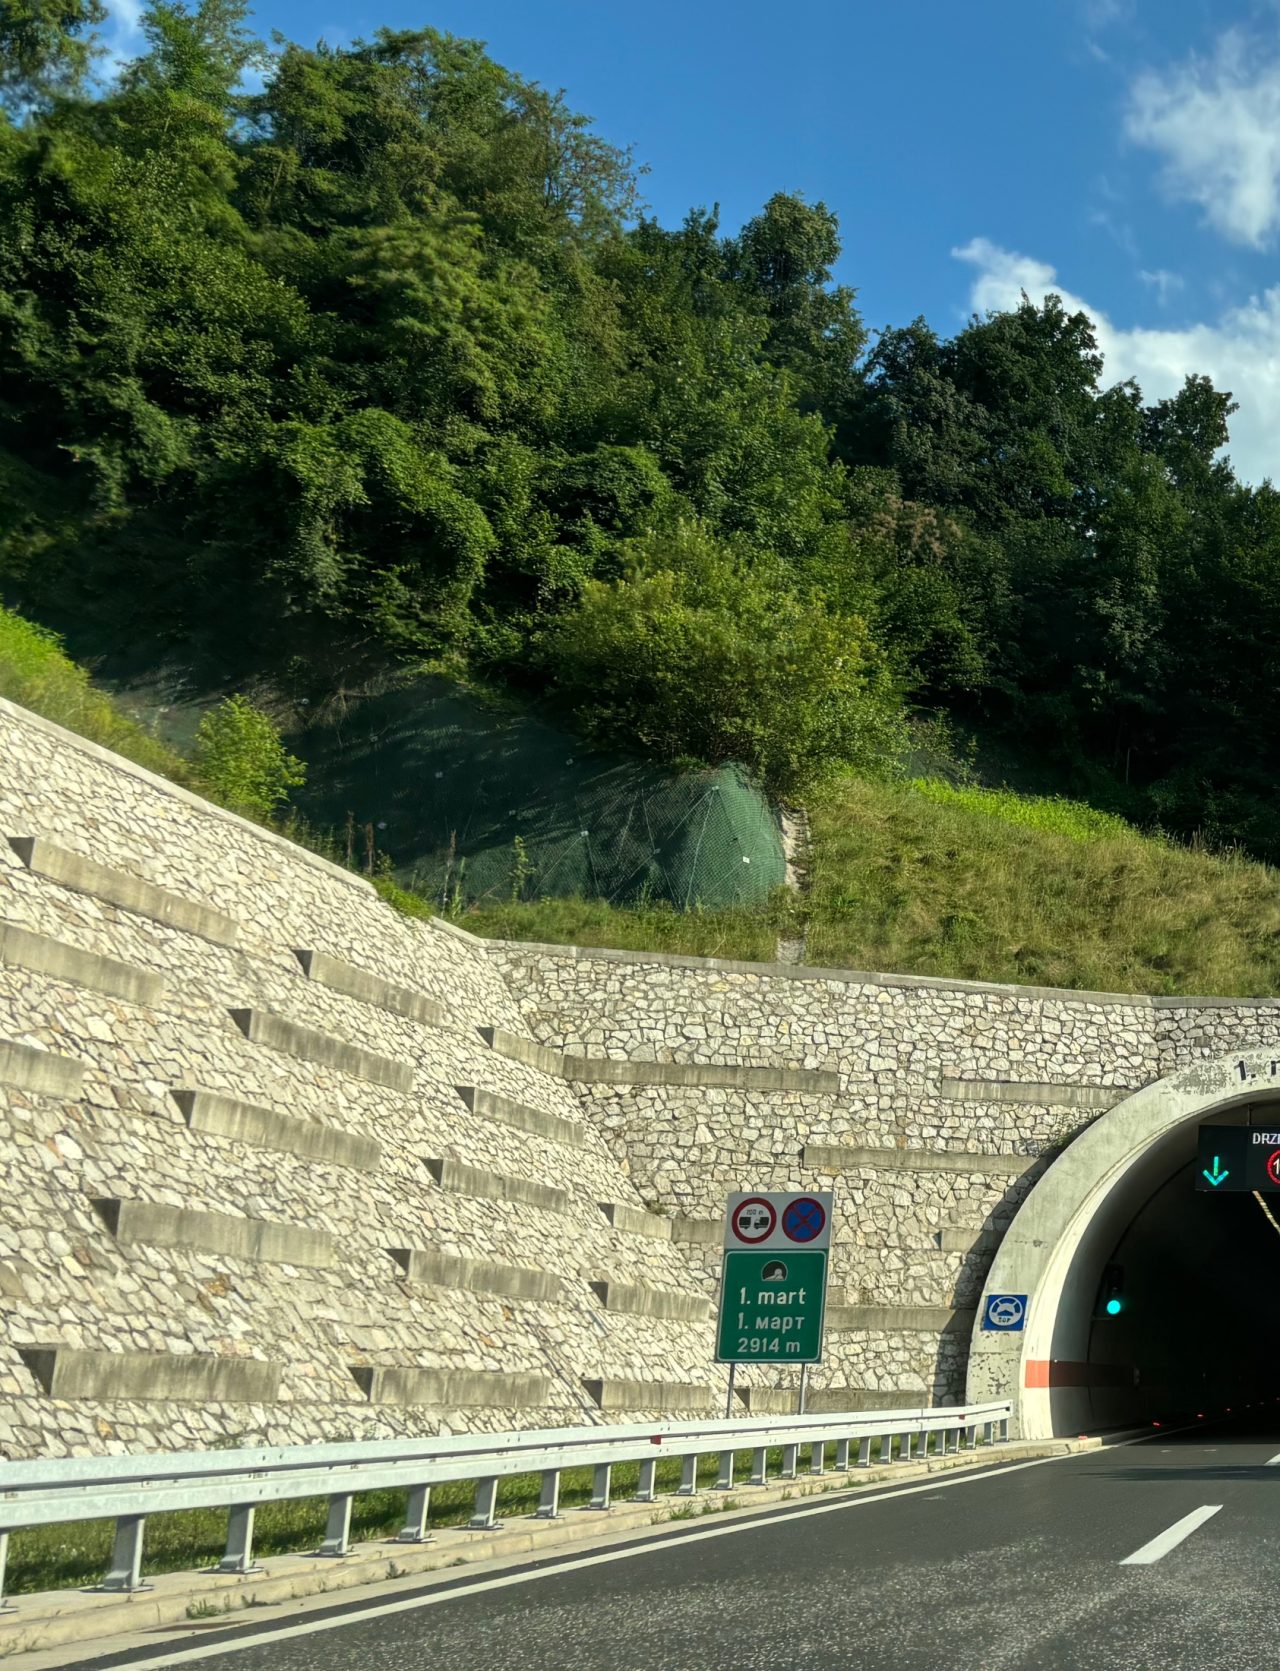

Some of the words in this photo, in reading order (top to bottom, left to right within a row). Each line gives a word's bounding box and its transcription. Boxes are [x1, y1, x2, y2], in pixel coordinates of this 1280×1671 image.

[1233, 1060, 1256, 1081] 1.
[1252, 1132, 1280, 1145] DRZI
[739, 1286, 751, 1305] 1.
[757, 1287, 806, 1305] mart
[737, 1312, 748, 1330] 1.
[755, 1315, 805, 1334] март
[737, 1337, 780, 1353] 2914
[785, 1341, 801, 1353] m
